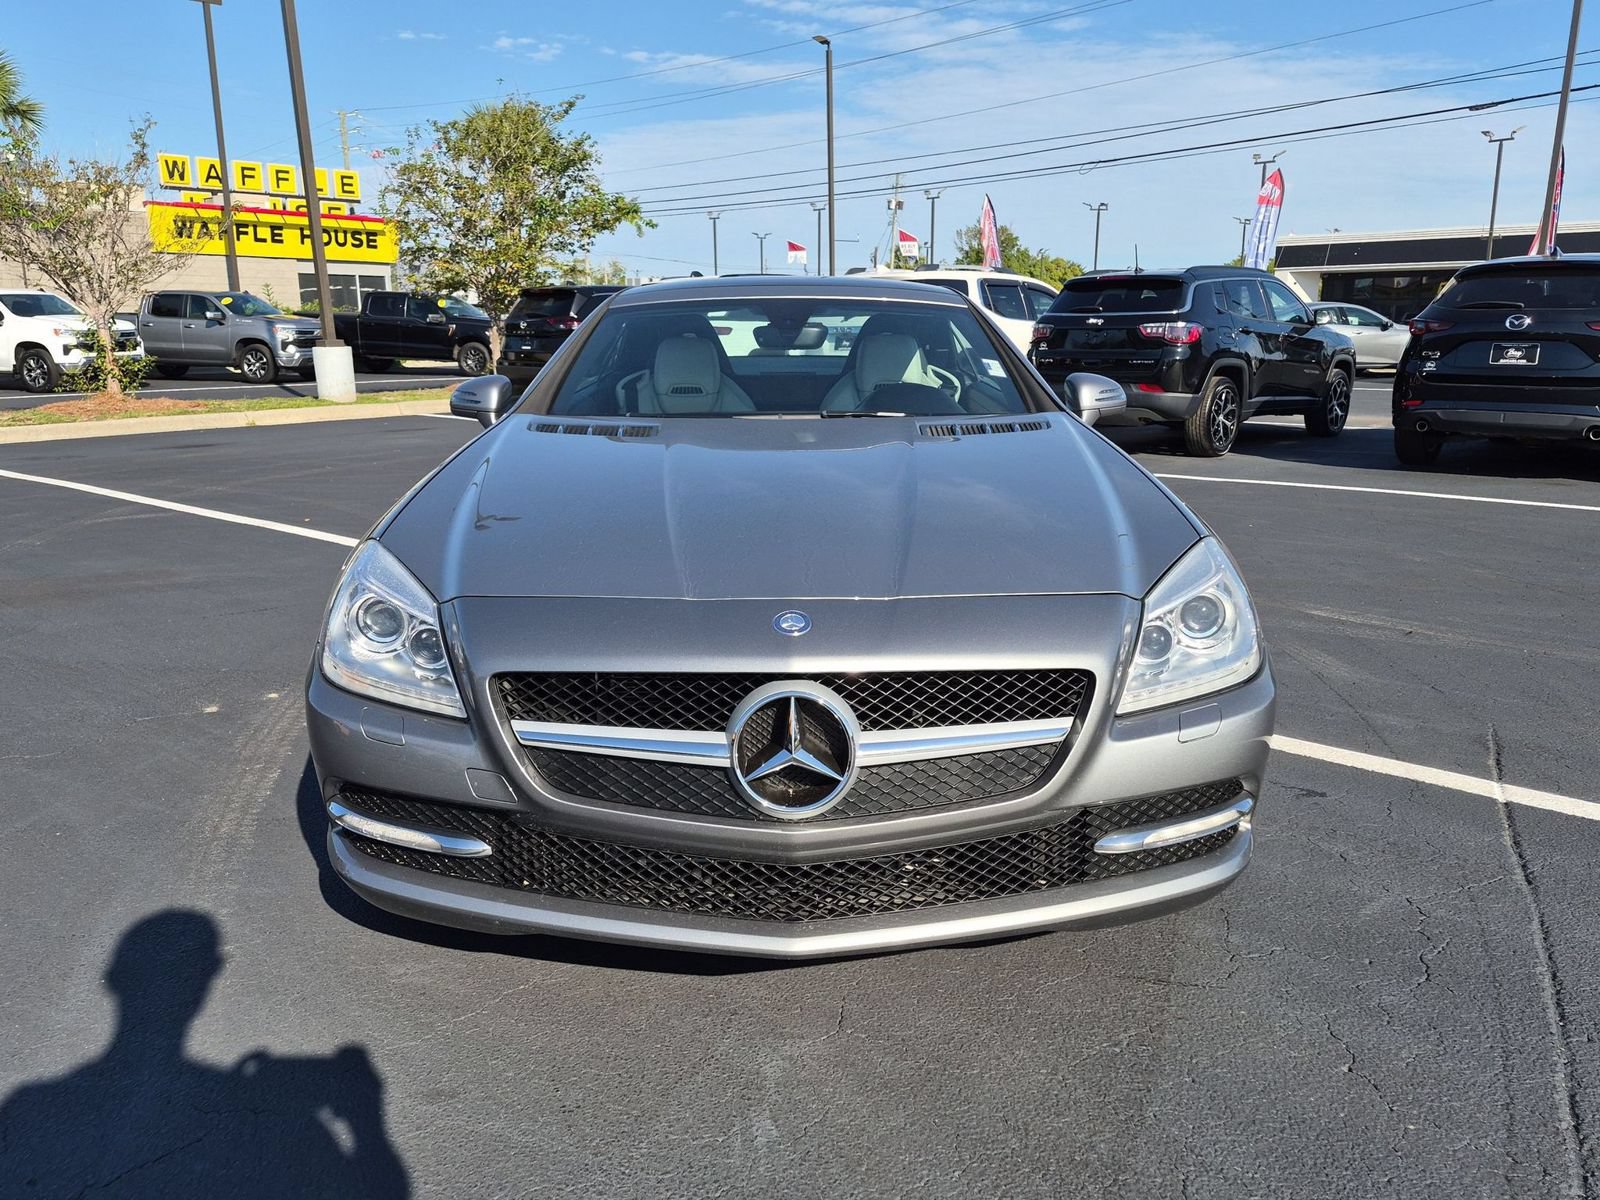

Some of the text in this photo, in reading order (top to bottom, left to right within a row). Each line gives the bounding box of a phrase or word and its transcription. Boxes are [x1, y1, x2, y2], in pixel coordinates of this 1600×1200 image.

[164, 159, 355, 194] WAFFE
[300, 227, 378, 249] HOUSE
[1086, 318, 1105, 326] Jeep
